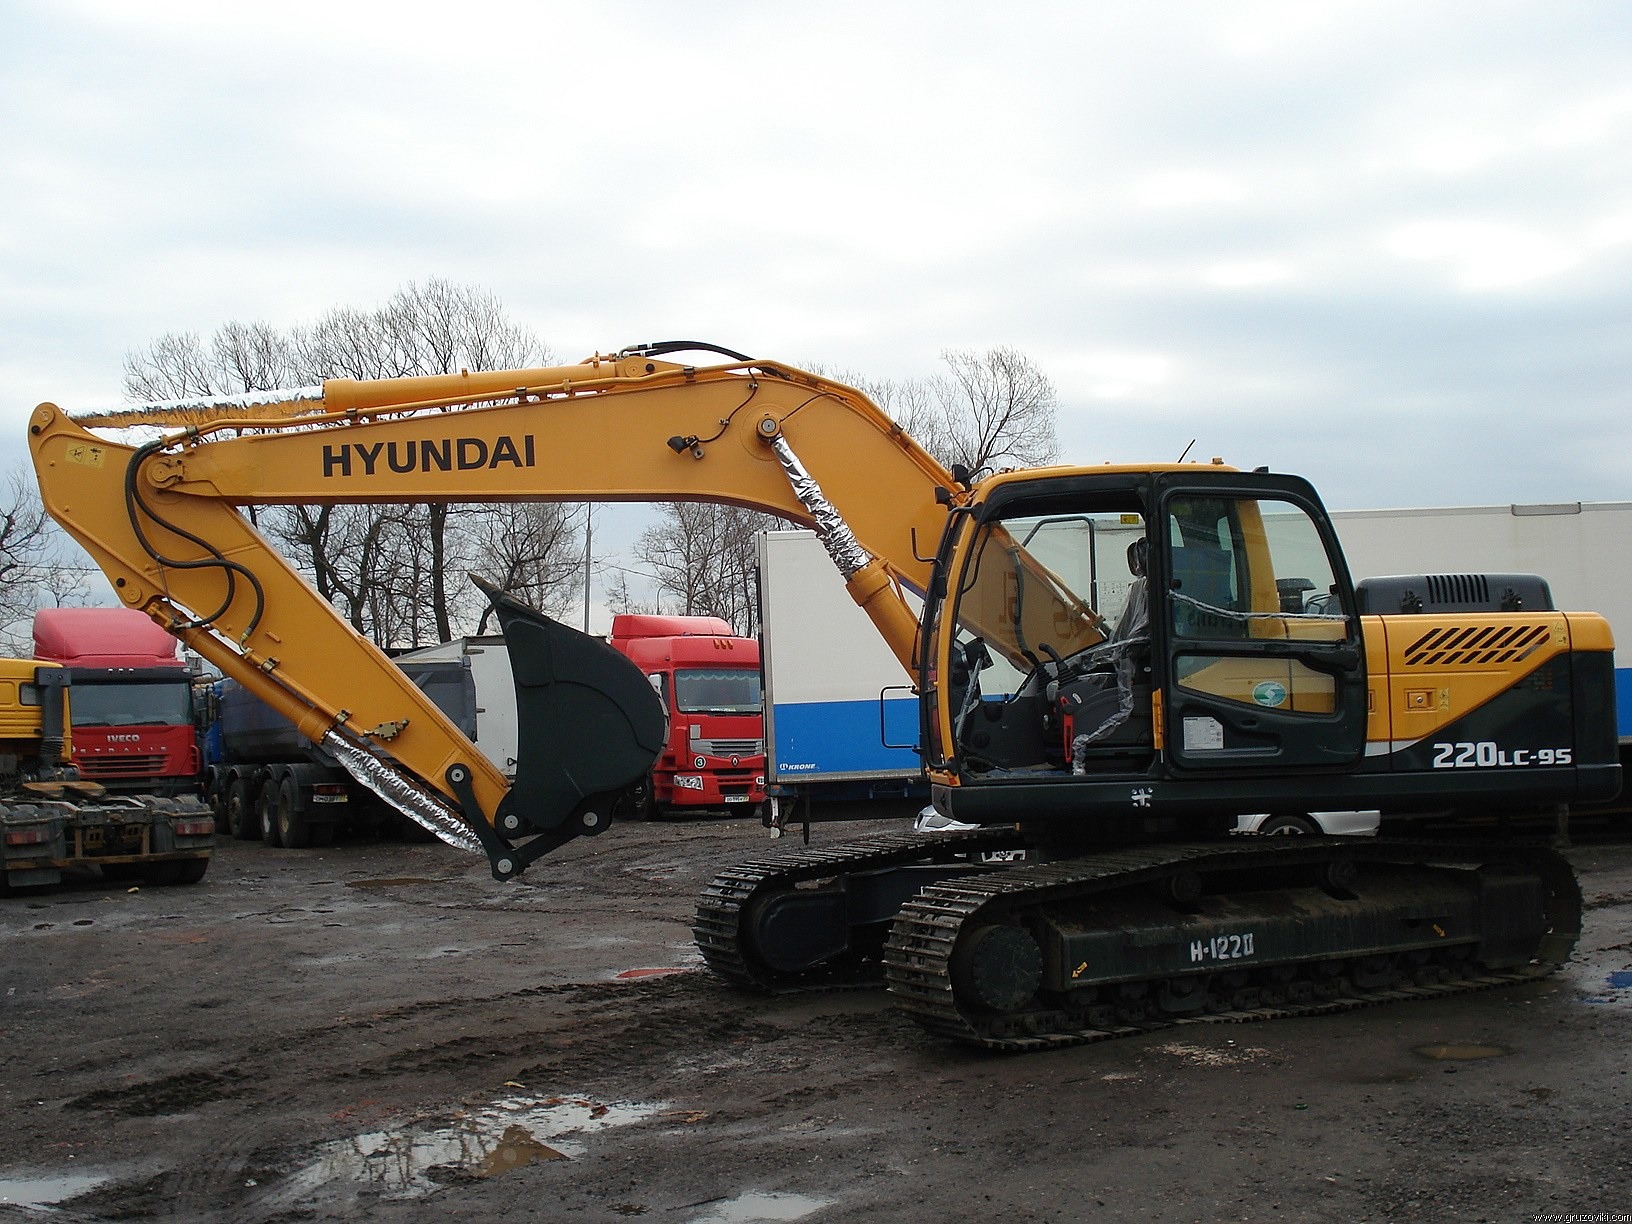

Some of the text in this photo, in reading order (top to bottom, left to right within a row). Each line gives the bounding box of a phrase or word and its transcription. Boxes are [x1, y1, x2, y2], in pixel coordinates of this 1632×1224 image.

[322, 435, 535, 477] HYUNDAI
[107, 734, 140, 743] IVECO
[788, 763, 816, 771] KRONE
